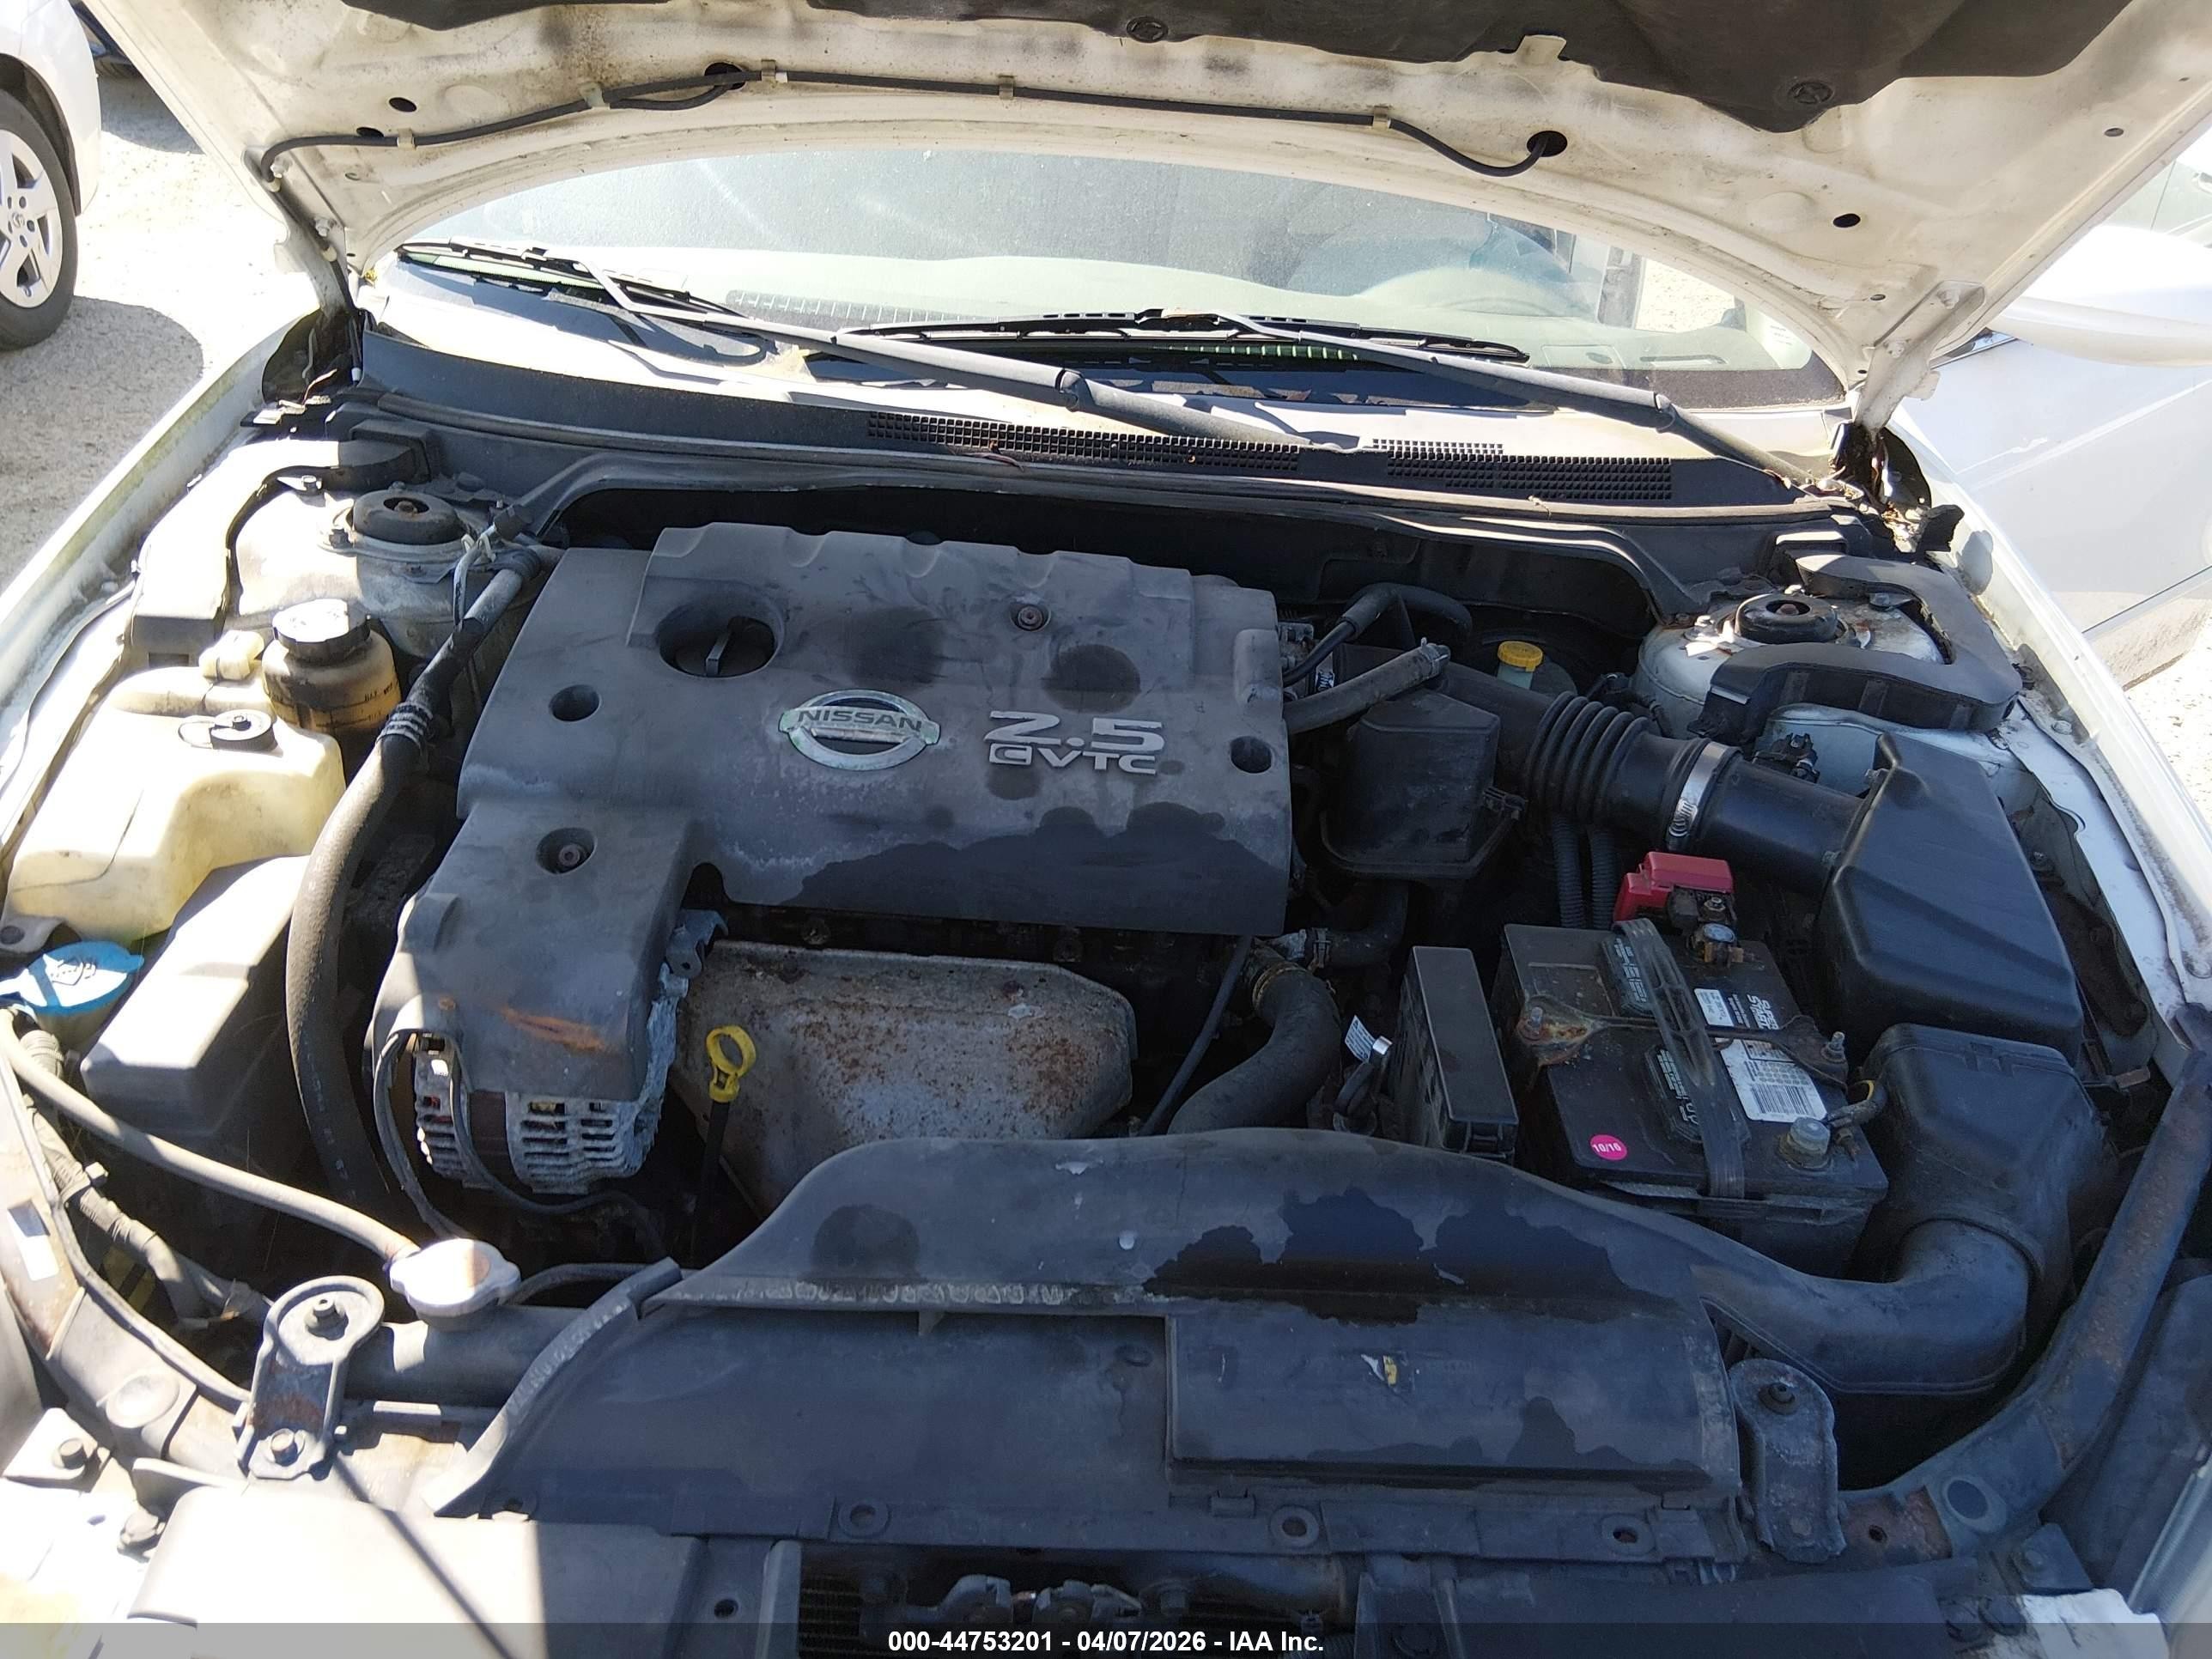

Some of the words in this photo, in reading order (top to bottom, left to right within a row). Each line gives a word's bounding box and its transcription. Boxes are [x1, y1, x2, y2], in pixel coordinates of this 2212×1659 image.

[798, 710, 922, 732] NISSAN
[983, 710, 1165, 751] 2.5
[1747, 994, 1771, 1030] START
[1760, 1000, 1779, 1030] SUPER
